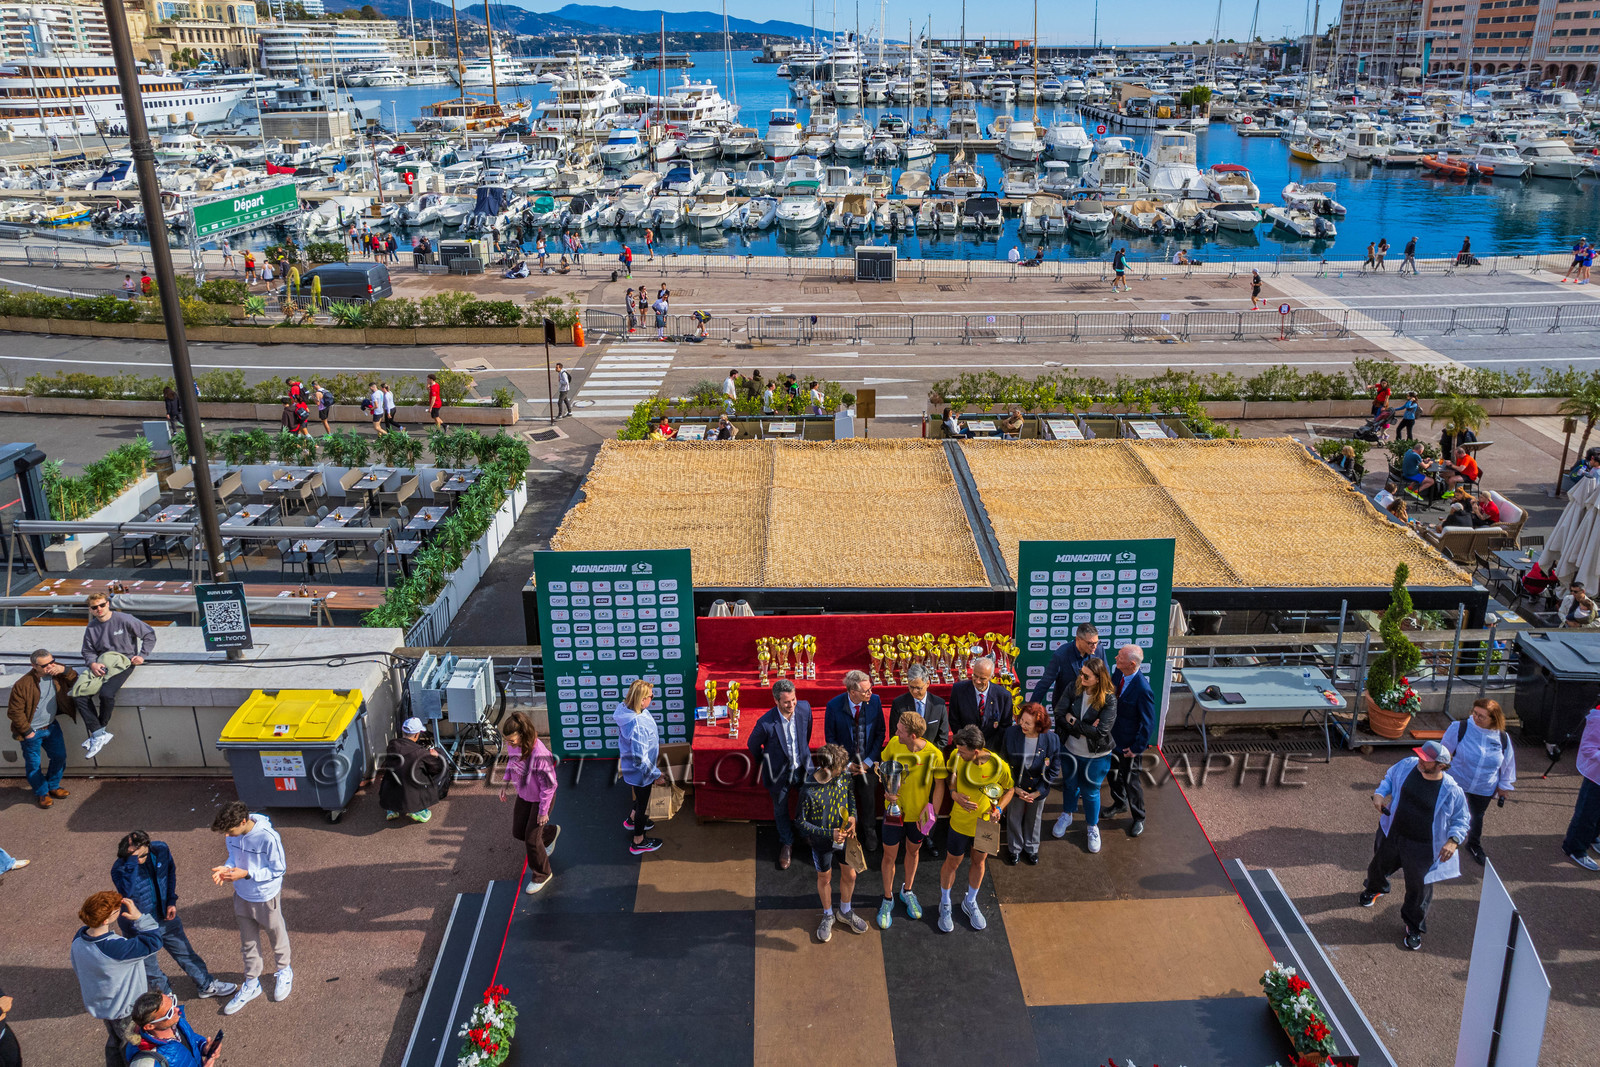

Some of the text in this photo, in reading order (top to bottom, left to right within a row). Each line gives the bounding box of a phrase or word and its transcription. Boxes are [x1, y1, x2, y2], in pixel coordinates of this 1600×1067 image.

[234, 195, 264, 212] Départ
[1055, 554, 1112, 563] MONACORUN
[571, 564, 628, 573] MONACORUN
[283, 778, 297, 791] M
